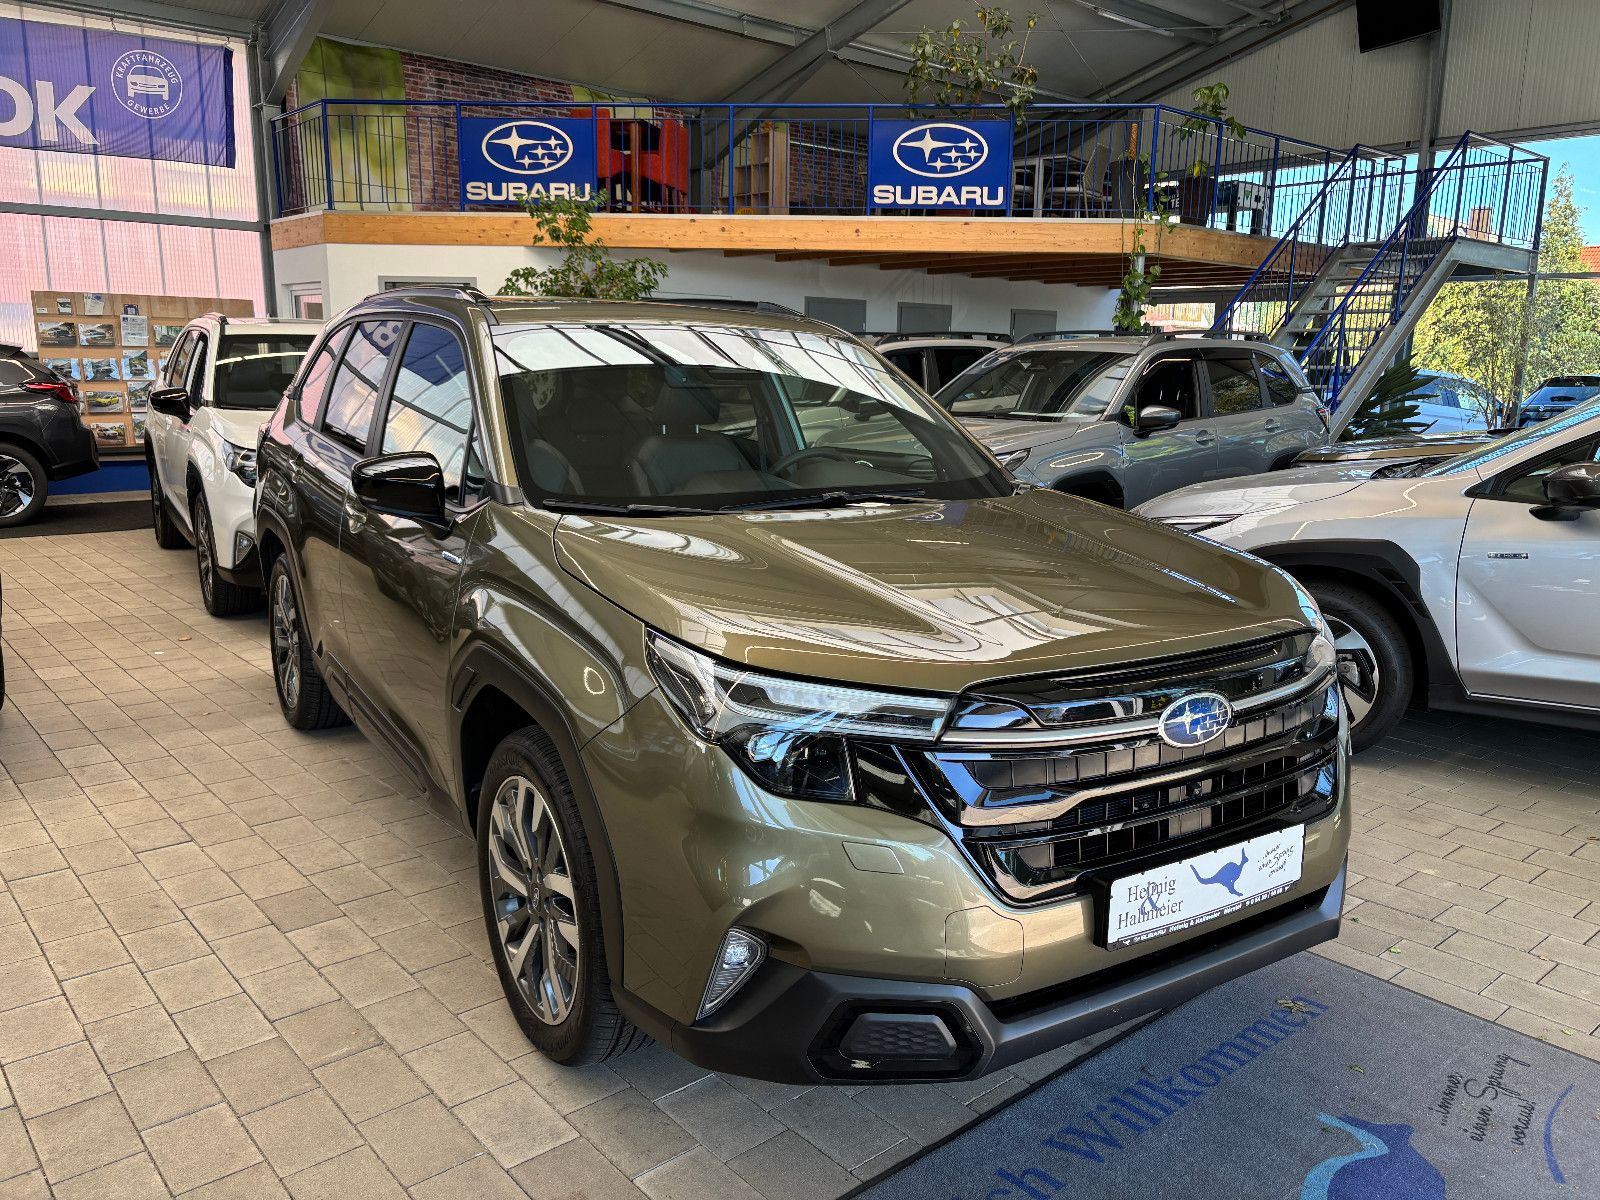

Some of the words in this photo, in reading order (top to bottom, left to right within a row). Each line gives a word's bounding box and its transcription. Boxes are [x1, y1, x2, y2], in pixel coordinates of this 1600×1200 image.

[116, 54, 178, 84] KRAFTFAHRZEUG
[127, 99, 170, 115] GEWERBE
[466, 181, 591, 202] SUBARU
[873, 184, 1004, 206] SUBARU
[1043, 994, 1330, 1163] Willkommen
[1463, 1052, 1531, 1101] Sprung
[1461, 1104, 1493, 1142] einen
